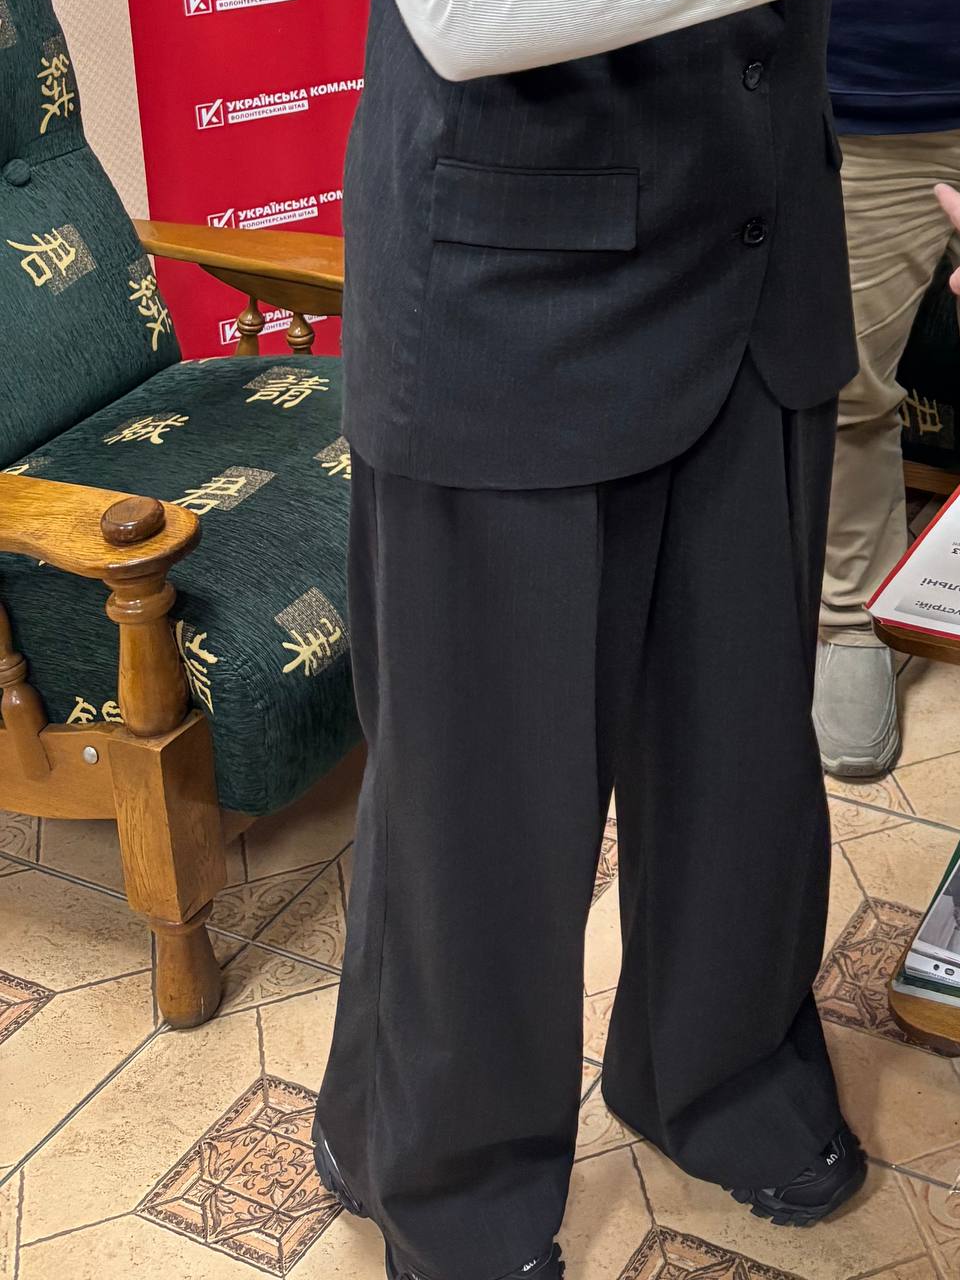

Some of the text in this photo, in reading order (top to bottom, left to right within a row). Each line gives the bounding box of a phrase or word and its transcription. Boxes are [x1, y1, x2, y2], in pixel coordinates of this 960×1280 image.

[227, 78, 364, 111] УКРАЇНСЬКА КОМАНД
[238, 196, 317, 220] УКРАЇНСЬКА
